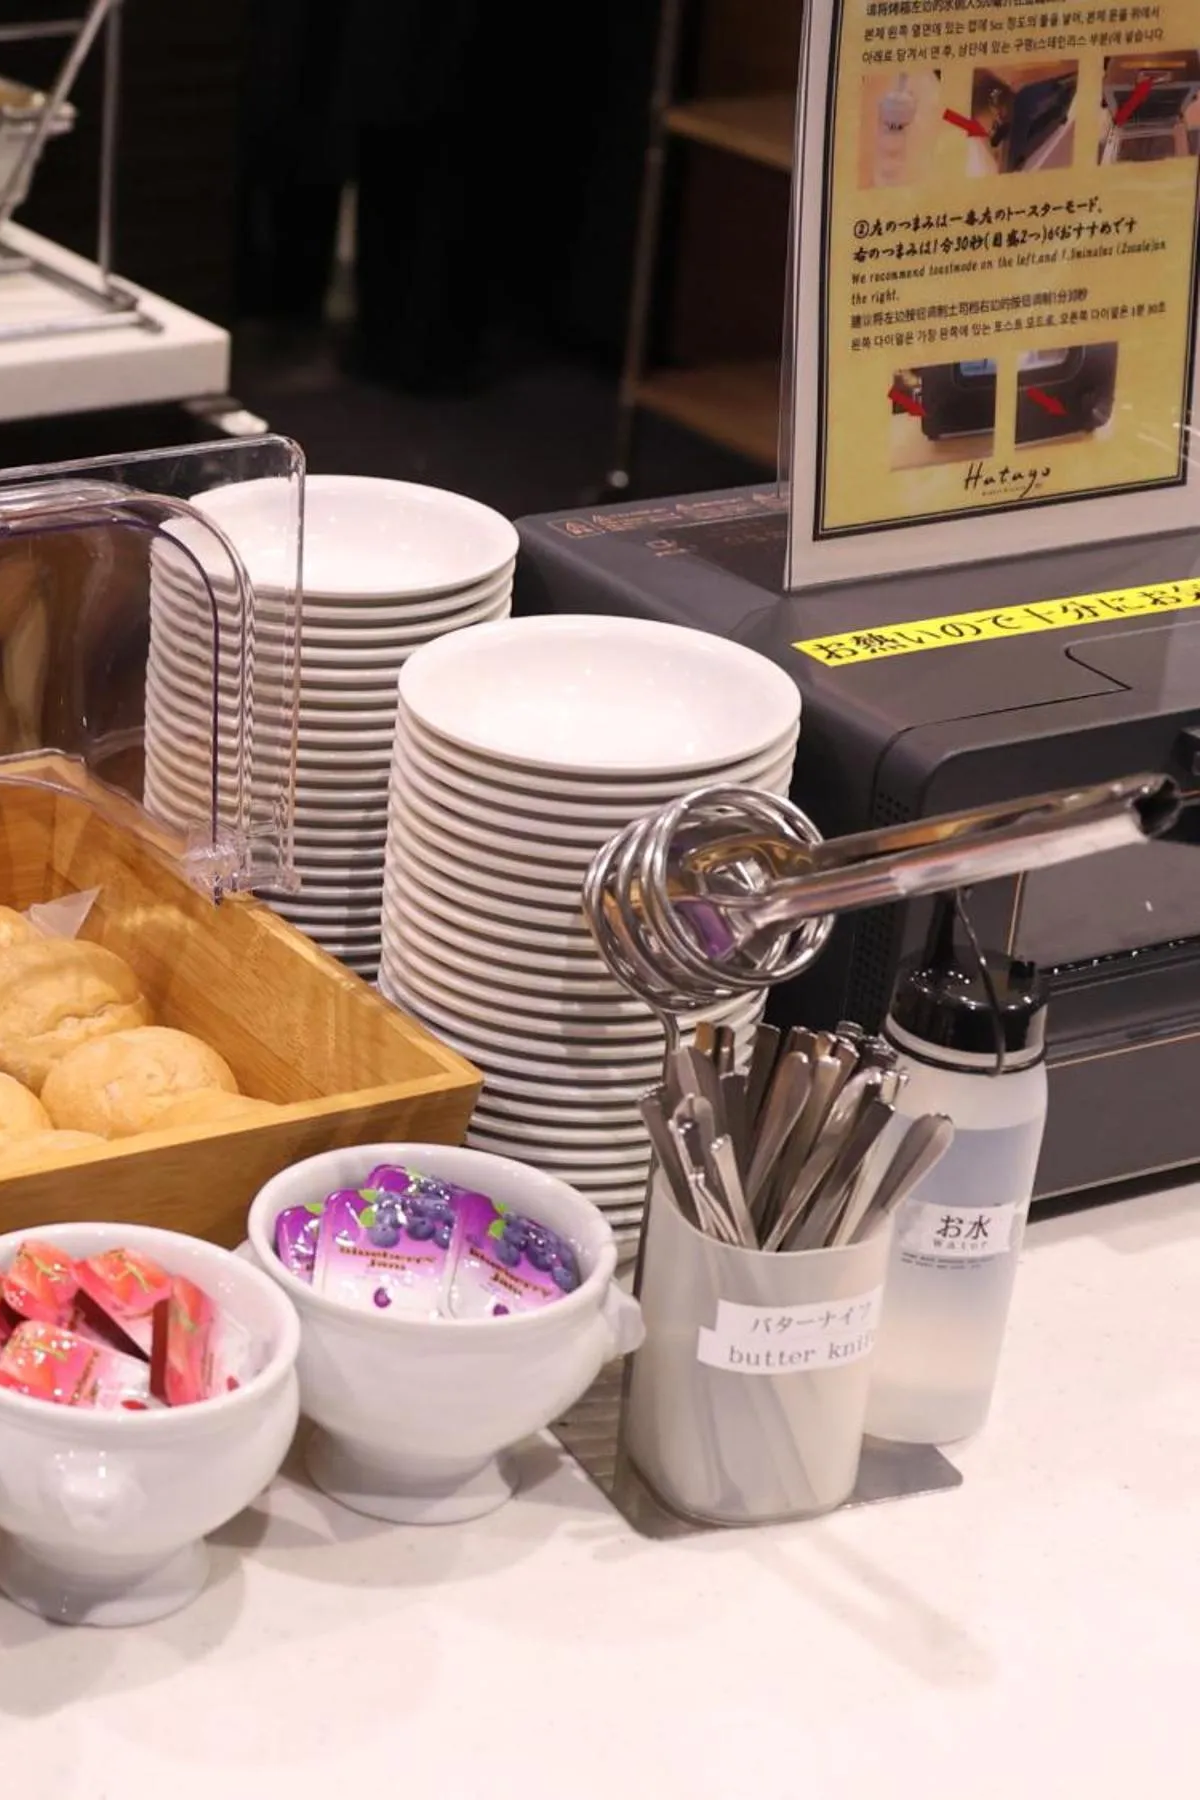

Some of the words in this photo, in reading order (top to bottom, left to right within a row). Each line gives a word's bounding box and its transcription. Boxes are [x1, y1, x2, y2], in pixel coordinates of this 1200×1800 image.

[852, 273, 867, 284] We
[870, 264, 925, 282] recommend
[980, 260, 993, 271] on
[998, 255, 1013, 268] the
[851, 291, 868, 306] the
[871, 287, 900, 305] right.
[936, 1215, 992, 1240] お水
[751, 1301, 872, 1334] バターナイフ
[729, 1344, 816, 1367] butter
